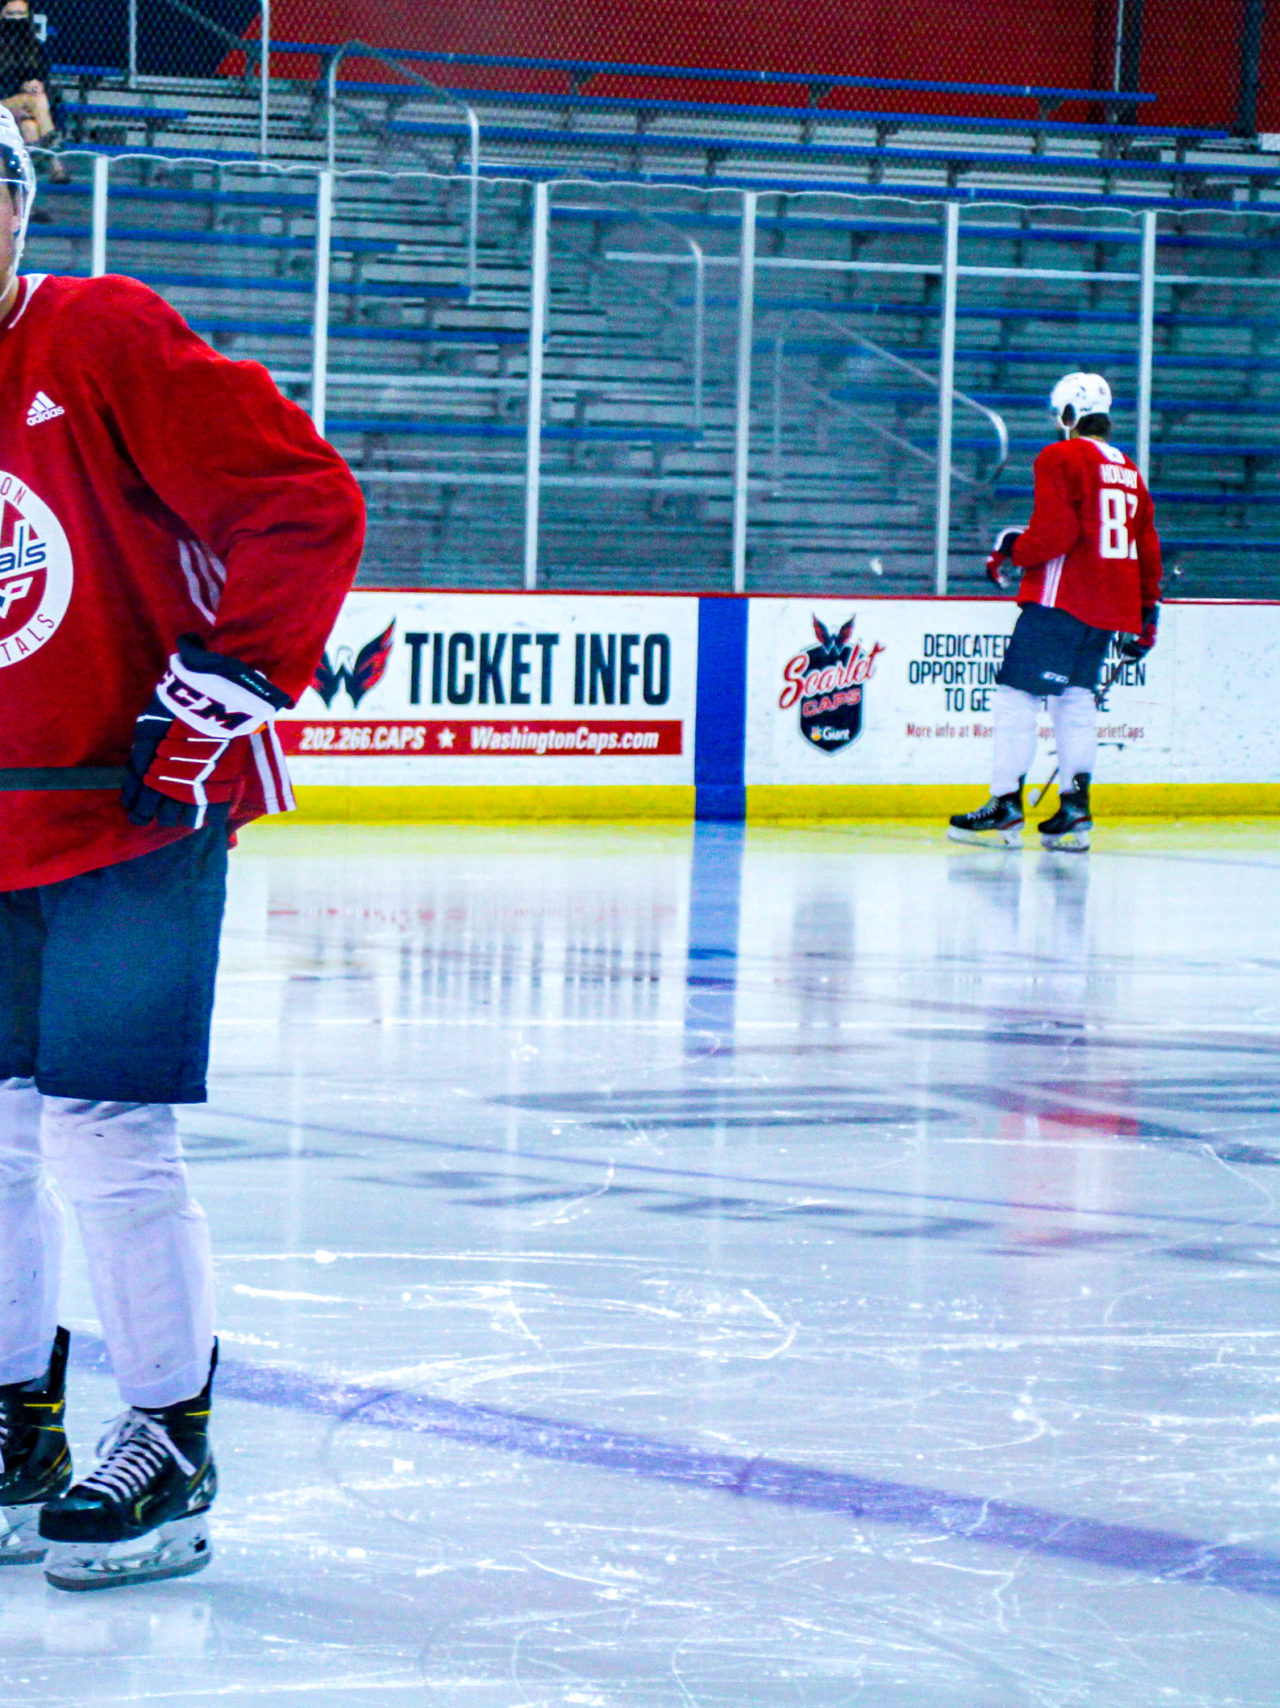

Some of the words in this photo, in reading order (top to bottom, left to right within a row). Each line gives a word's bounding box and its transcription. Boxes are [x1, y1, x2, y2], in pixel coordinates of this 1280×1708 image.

[27, 406, 65, 426] adidas
[404, 633, 560, 705] TICKET
[573, 633, 670, 706] INFO
[778, 642, 885, 709] Scarlet
[1099, 662, 1146, 686] OMEN
[803, 688, 861, 717] CAPS
[945, 688, 965, 711] TO
[971, 687, 997, 711] GE
[299, 726, 426, 750] 202.266.CAPS
[470, 726, 659, 754] WashingtonCaps.com
[907, 723, 932, 738] More
[935, 723, 956, 738] info
[958, 726, 971, 738] at
